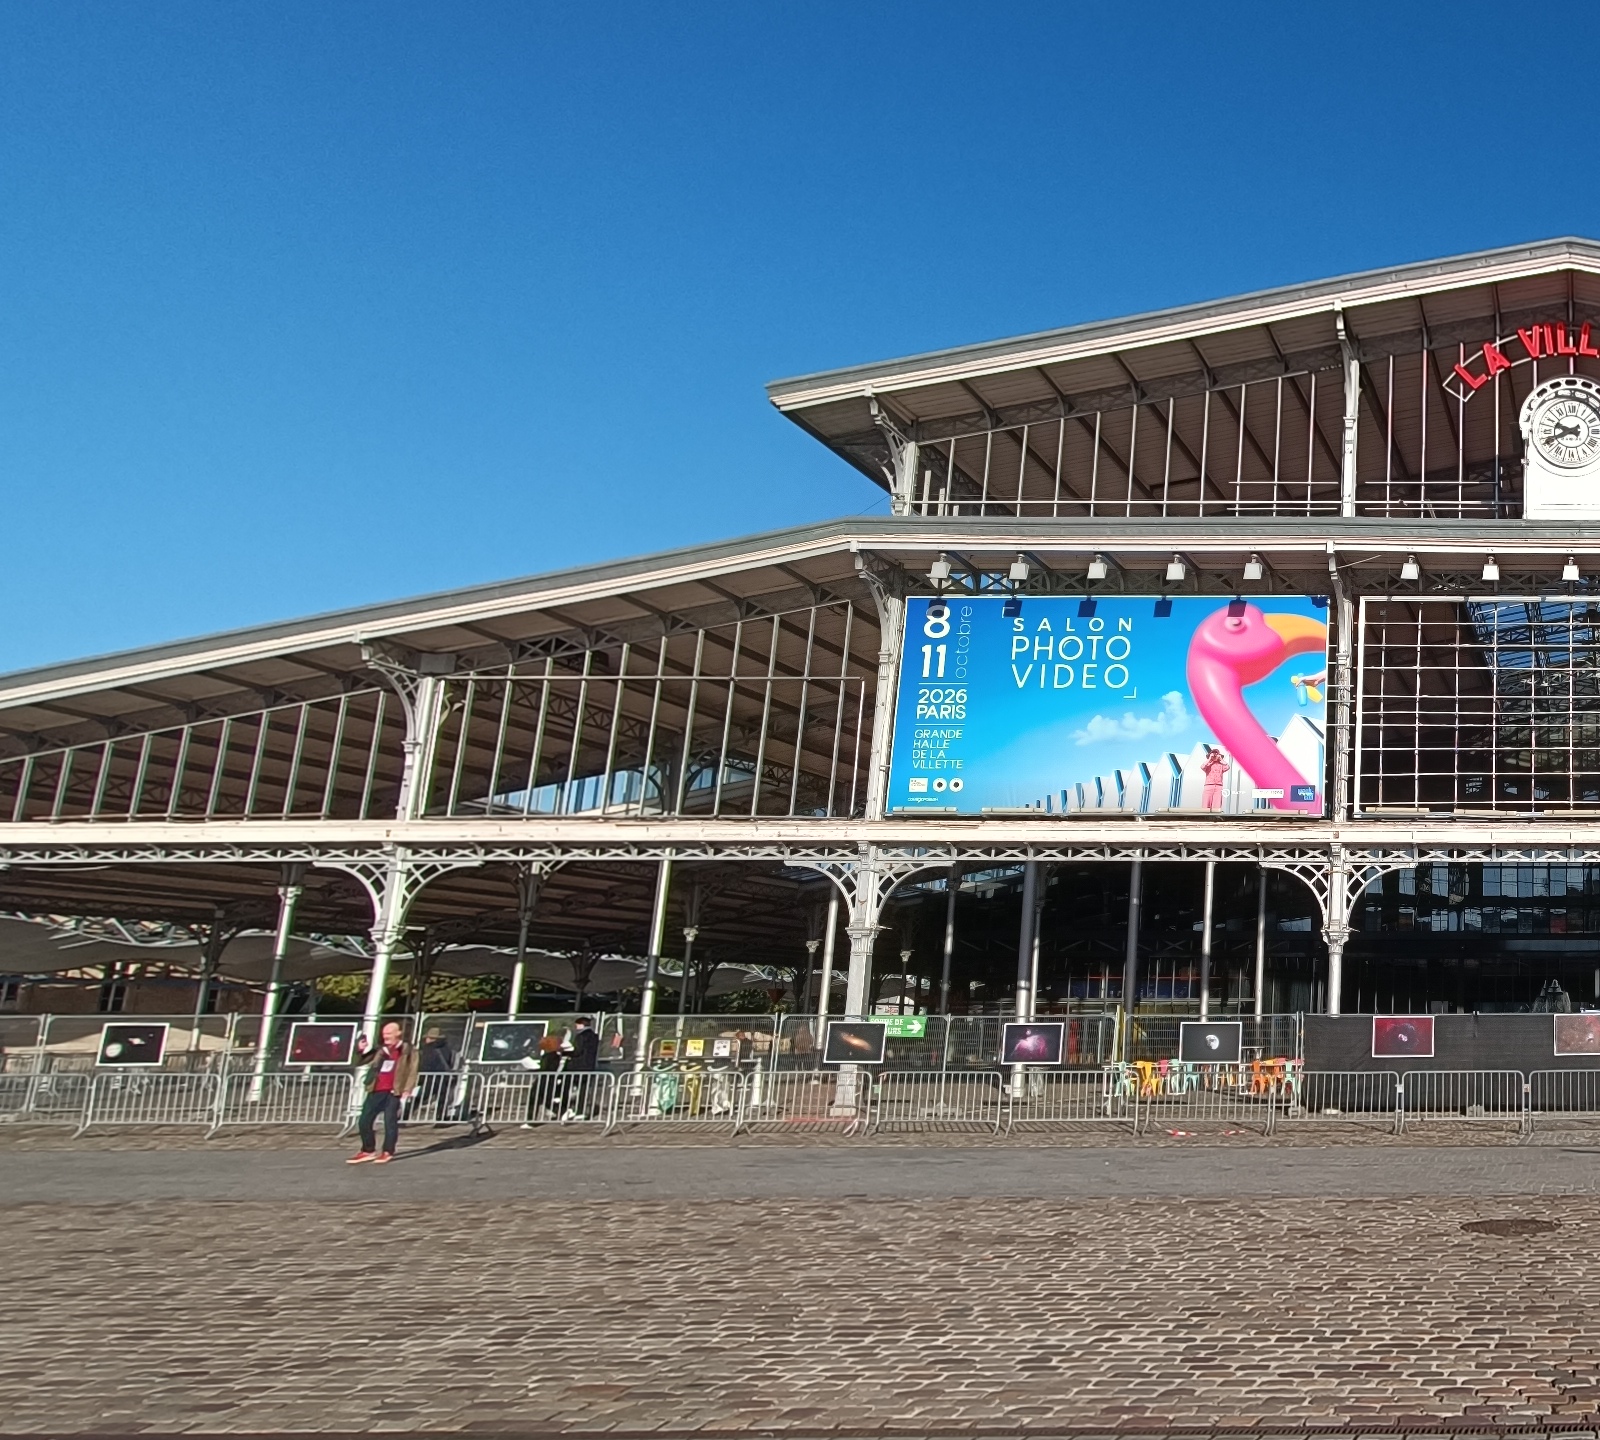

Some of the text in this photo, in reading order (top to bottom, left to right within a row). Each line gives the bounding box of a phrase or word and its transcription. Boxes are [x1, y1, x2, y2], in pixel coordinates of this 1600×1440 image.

[1454, 342, 1512, 390] LA
[923, 604, 951, 639] 8
[1012, 617, 1132, 632] SALON
[955, 605, 973, 679] octobre
[1011, 635, 1131, 661] PHOTO
[921, 644, 947, 678] 11
[1011, 663, 1129, 689] VIDEO
[918, 688, 968, 704] 2026
[916, 704, 967, 720] PARIS
[914, 729, 963, 739] GRANDE
[913, 740, 951, 749] HALLE
[912, 750, 946, 759] DE LA
[912, 760, 963, 769] VILLETTE
